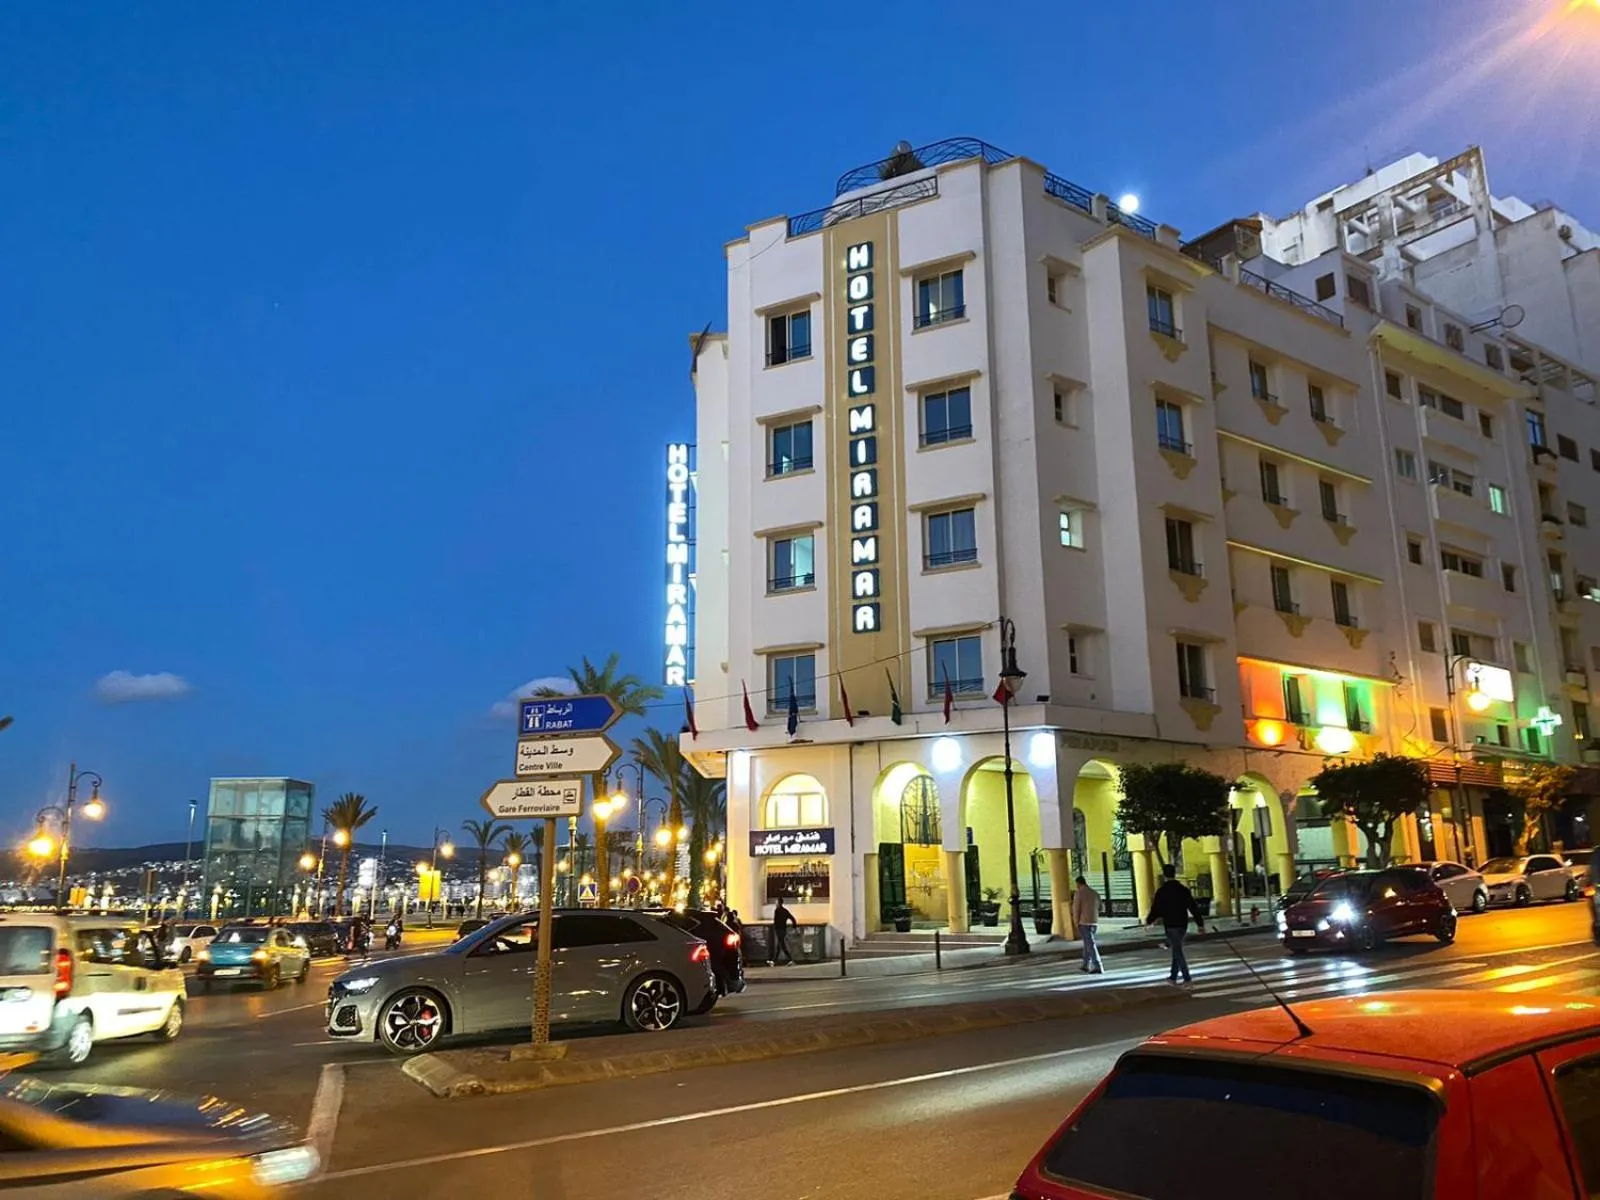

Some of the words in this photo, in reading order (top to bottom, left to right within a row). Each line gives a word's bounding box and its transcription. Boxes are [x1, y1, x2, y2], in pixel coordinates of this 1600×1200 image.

[848, 243, 872, 394] HOTEL
[667, 444, 688, 542] HOTEL
[850, 407, 876, 631] MIRAMAR
[666, 543, 688, 686] MIRAMAR
[546, 703, 574, 716] الرباط
[545, 720, 574, 729] RABAT
[520, 745, 548, 759] المدينة
[550, 745, 574, 756] وسط
[519, 763, 544, 772] Centre
[545, 762, 563, 770] Ville
[512, 785, 535, 800] القطار
[538, 786, 561, 796] محطة
[499, 805, 516, 813] Gare
[518, 804, 561, 813] Ferroviaire
[795, 831, 820, 842] فندق
[754, 844, 784, 855] HOTEL
[785, 842, 827, 854] MIRAMAR
